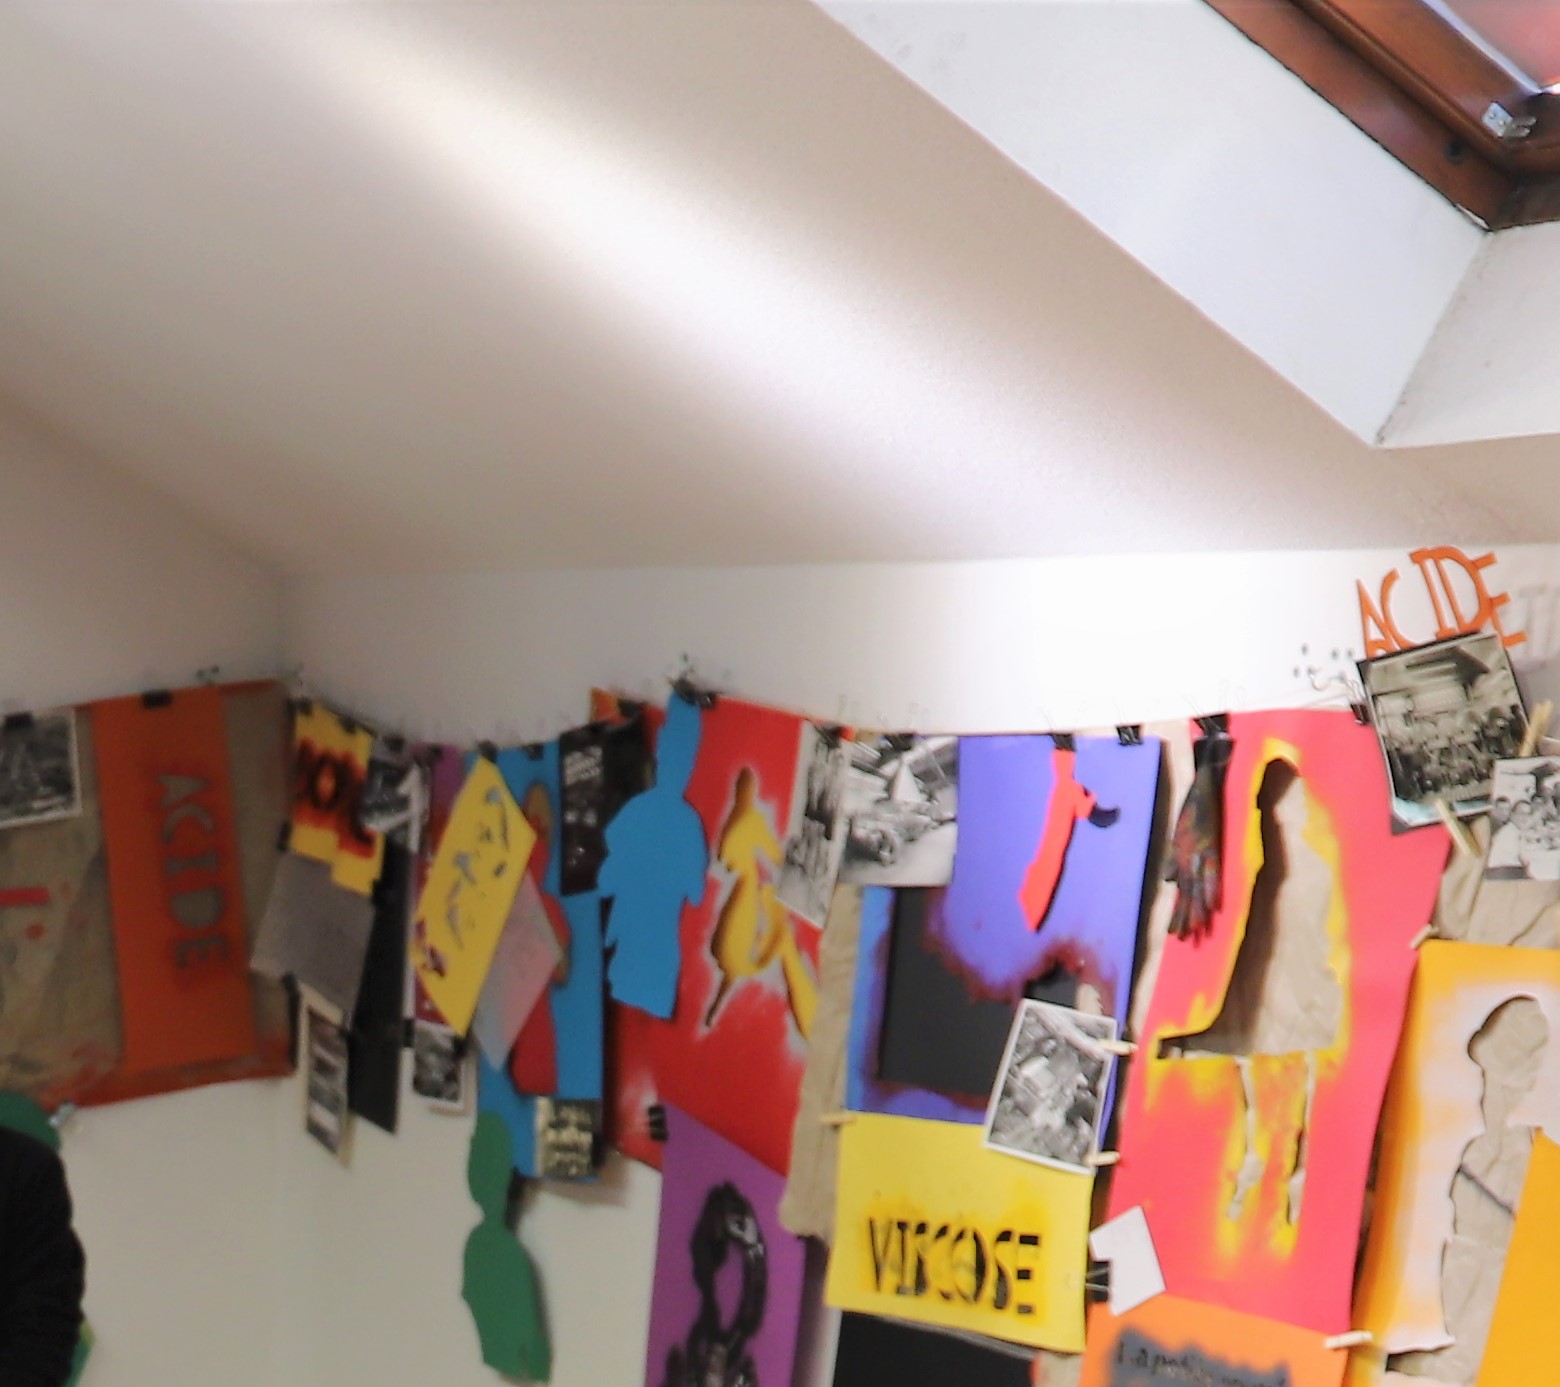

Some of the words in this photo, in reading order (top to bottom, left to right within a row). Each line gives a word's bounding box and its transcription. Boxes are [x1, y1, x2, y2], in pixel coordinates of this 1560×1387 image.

[1356, 545, 1528, 660] ACIDE
[156, 772, 230, 969] ACIDE
[869, 1216, 1041, 1316] VISCOSE
